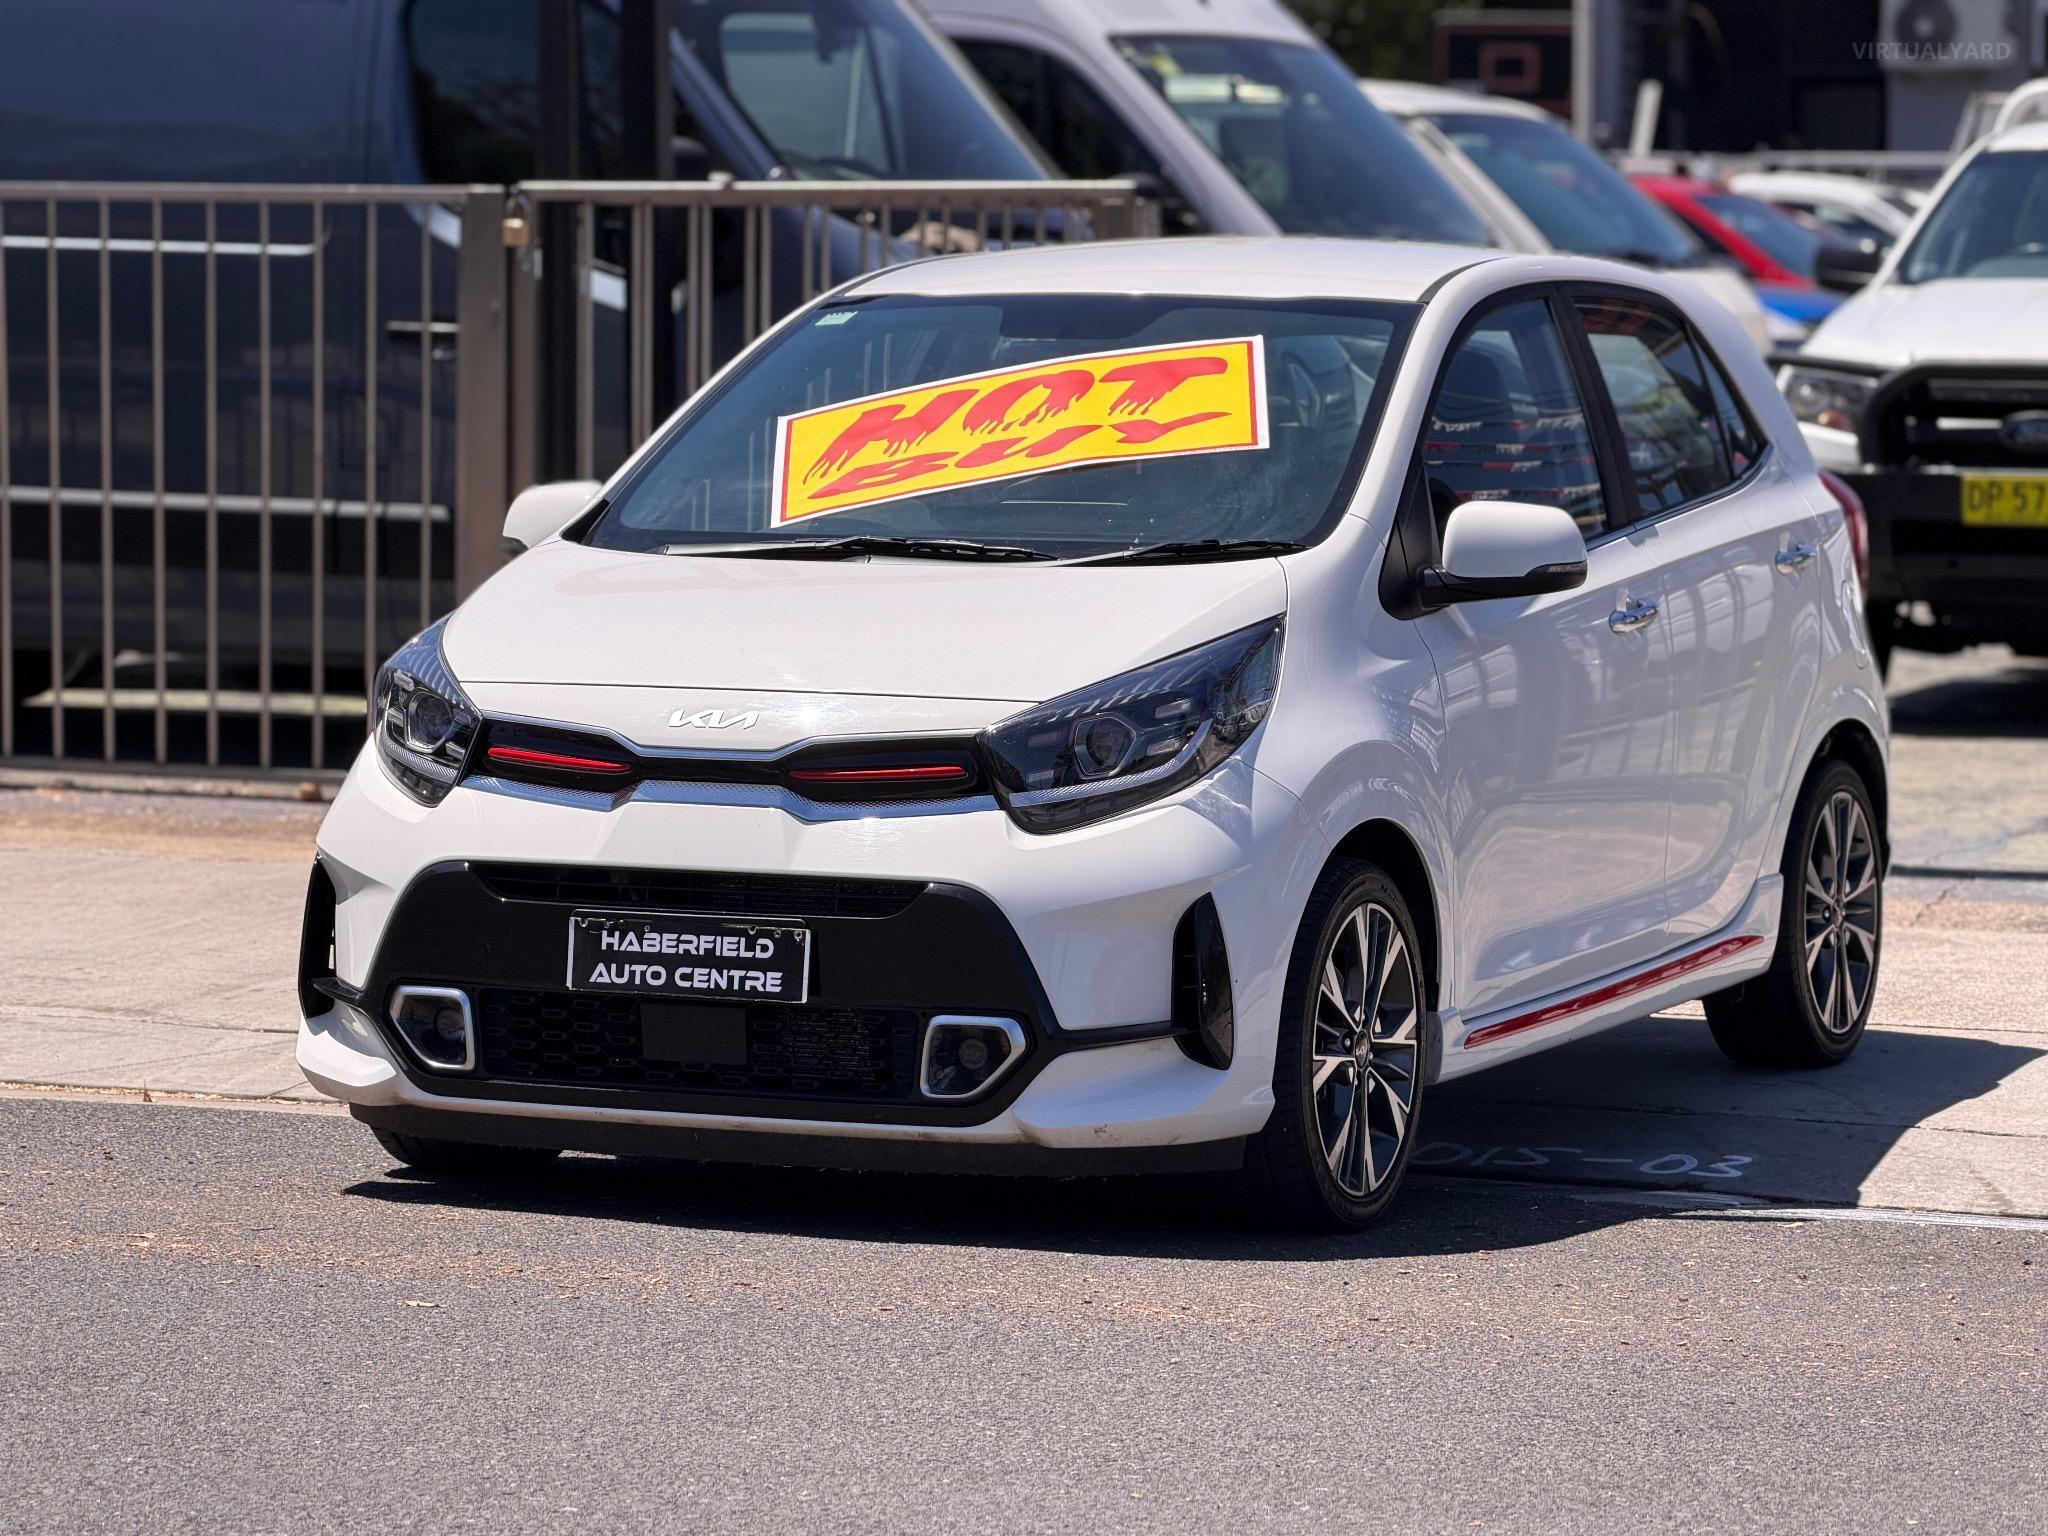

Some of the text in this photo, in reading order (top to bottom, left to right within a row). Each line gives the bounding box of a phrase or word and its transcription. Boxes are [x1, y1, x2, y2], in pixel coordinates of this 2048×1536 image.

[803, 357, 1229, 485] HOT
[807, 411, 1233, 500] BUY
[668, 708, 760, 730] KIA
[601, 930, 775, 959] HABERFIELD
[589, 962, 783, 993] AUTO CENTRE
